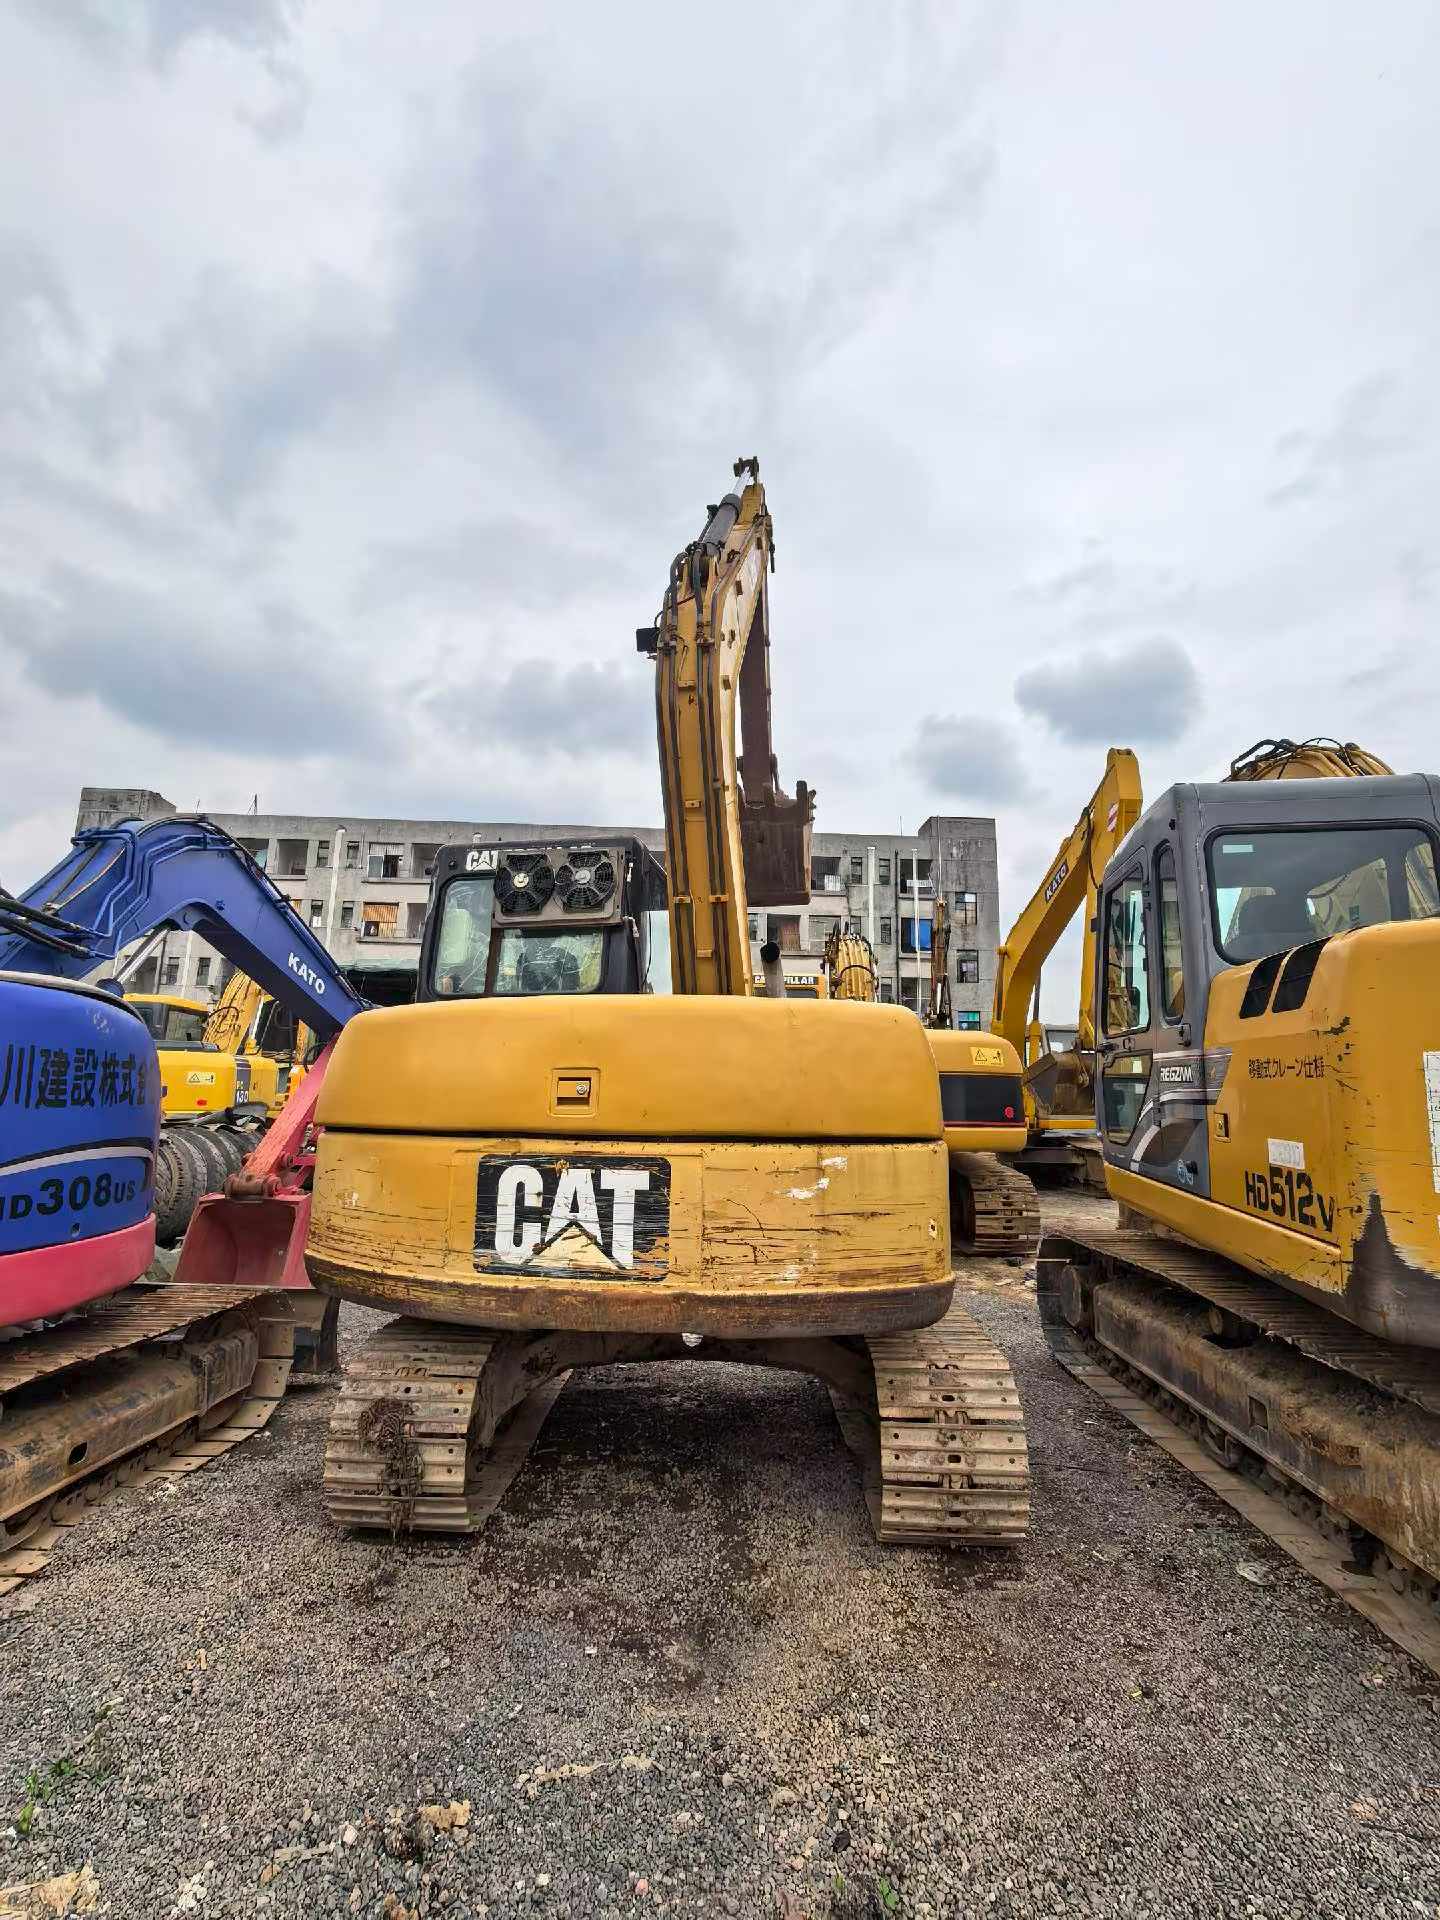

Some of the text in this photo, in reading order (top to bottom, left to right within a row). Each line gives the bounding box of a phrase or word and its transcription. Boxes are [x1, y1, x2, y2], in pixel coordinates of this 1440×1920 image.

[465, 850, 498, 871] CAT
[1046, 863, 1067, 901] KATO
[288, 952, 325, 994] KATO
[754, 975, 814, 985] CAPILLAR
[1160, 1066, 1193, 1082] REGZAM
[1249, 1055, 1324, 1079] 移動式クレーン仕様
[236, 1090, 249, 1103] 130
[1244, 1165, 1335, 1232] HD512V
[495, 1164, 650, 1270] CAT
